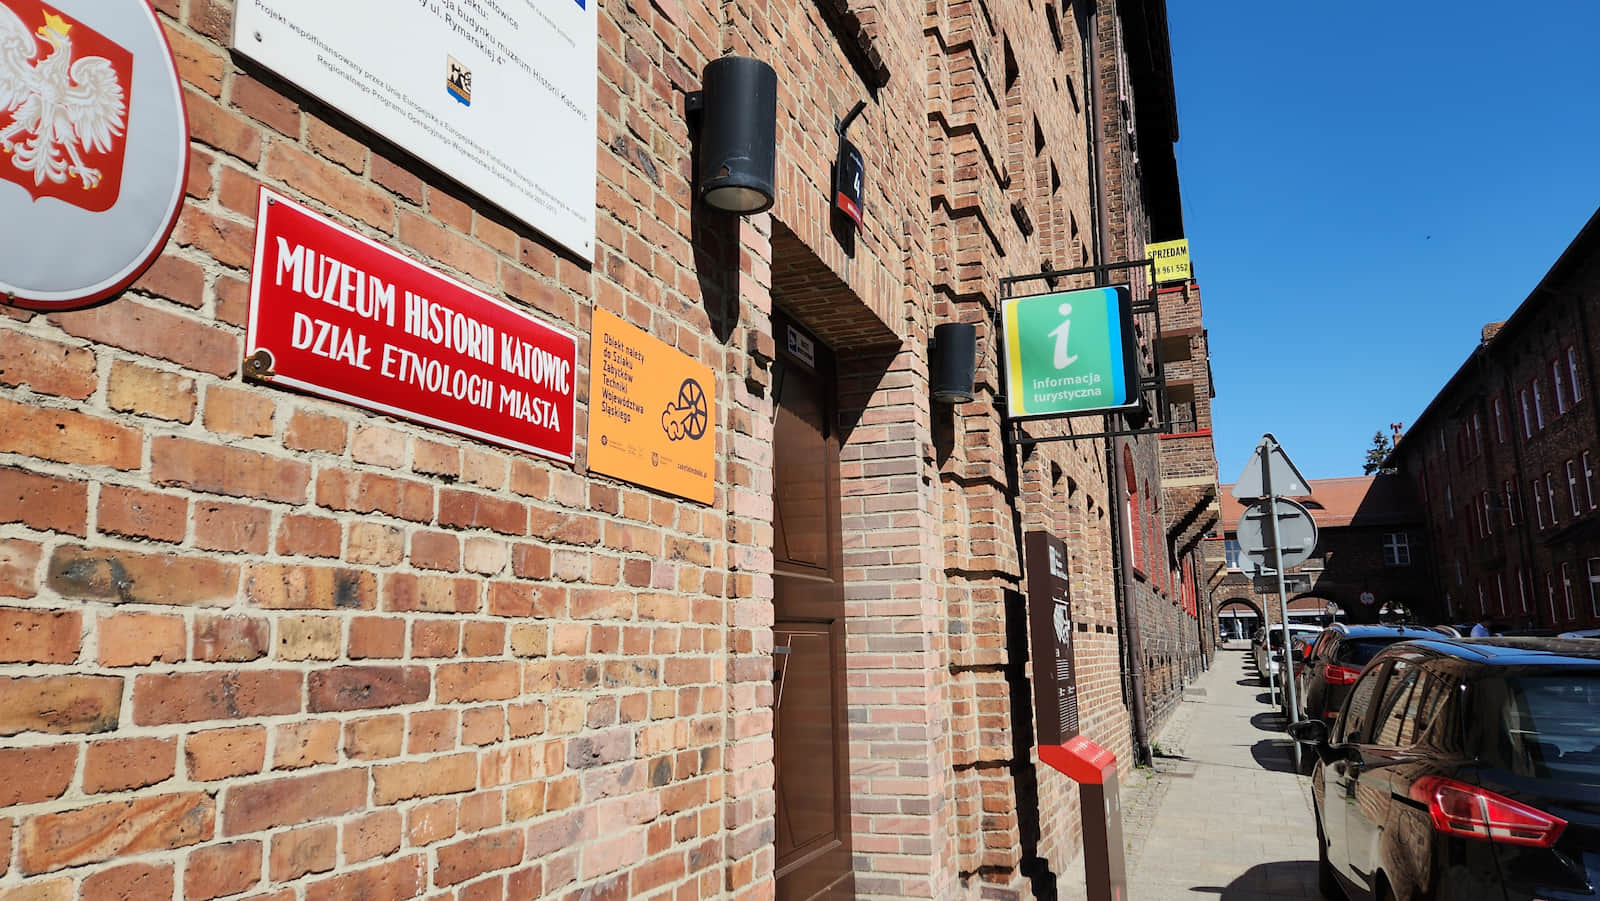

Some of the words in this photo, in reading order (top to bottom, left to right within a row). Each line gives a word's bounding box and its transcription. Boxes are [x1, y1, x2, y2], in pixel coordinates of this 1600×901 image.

[255, 0, 287, 24] Projekt
[457, 5, 496, 43] budynku
[484, 0, 518, 30] atowice
[430, 3, 442, 18] ul.
[445, 12, 495, 62] Rymarskiej
[853, 171, 862, 198] 4
[1147, 246, 1187, 259] SPRZEDAM
[275, 235, 396, 328] MUZEUM
[404, 290, 495, 365] HISTORII
[501, 331, 570, 396] KATOWIC
[603, 333, 624, 353] Obiekt
[625, 346, 645, 366] należy
[603, 347, 611, 360] do
[613, 351, 633, 370] Szlaku
[291, 311, 372, 371] DZIAŁ
[380, 343, 494, 410] ETNOLOGII
[499, 384, 561, 432] MIASTA
[602, 374, 627, 394] Techniki
[603, 360, 634, 383] Zabytków
[1033, 373, 1101, 389] informacja
[602, 387, 644, 415] Województwa
[1034, 387, 1102, 403] turystyczna
